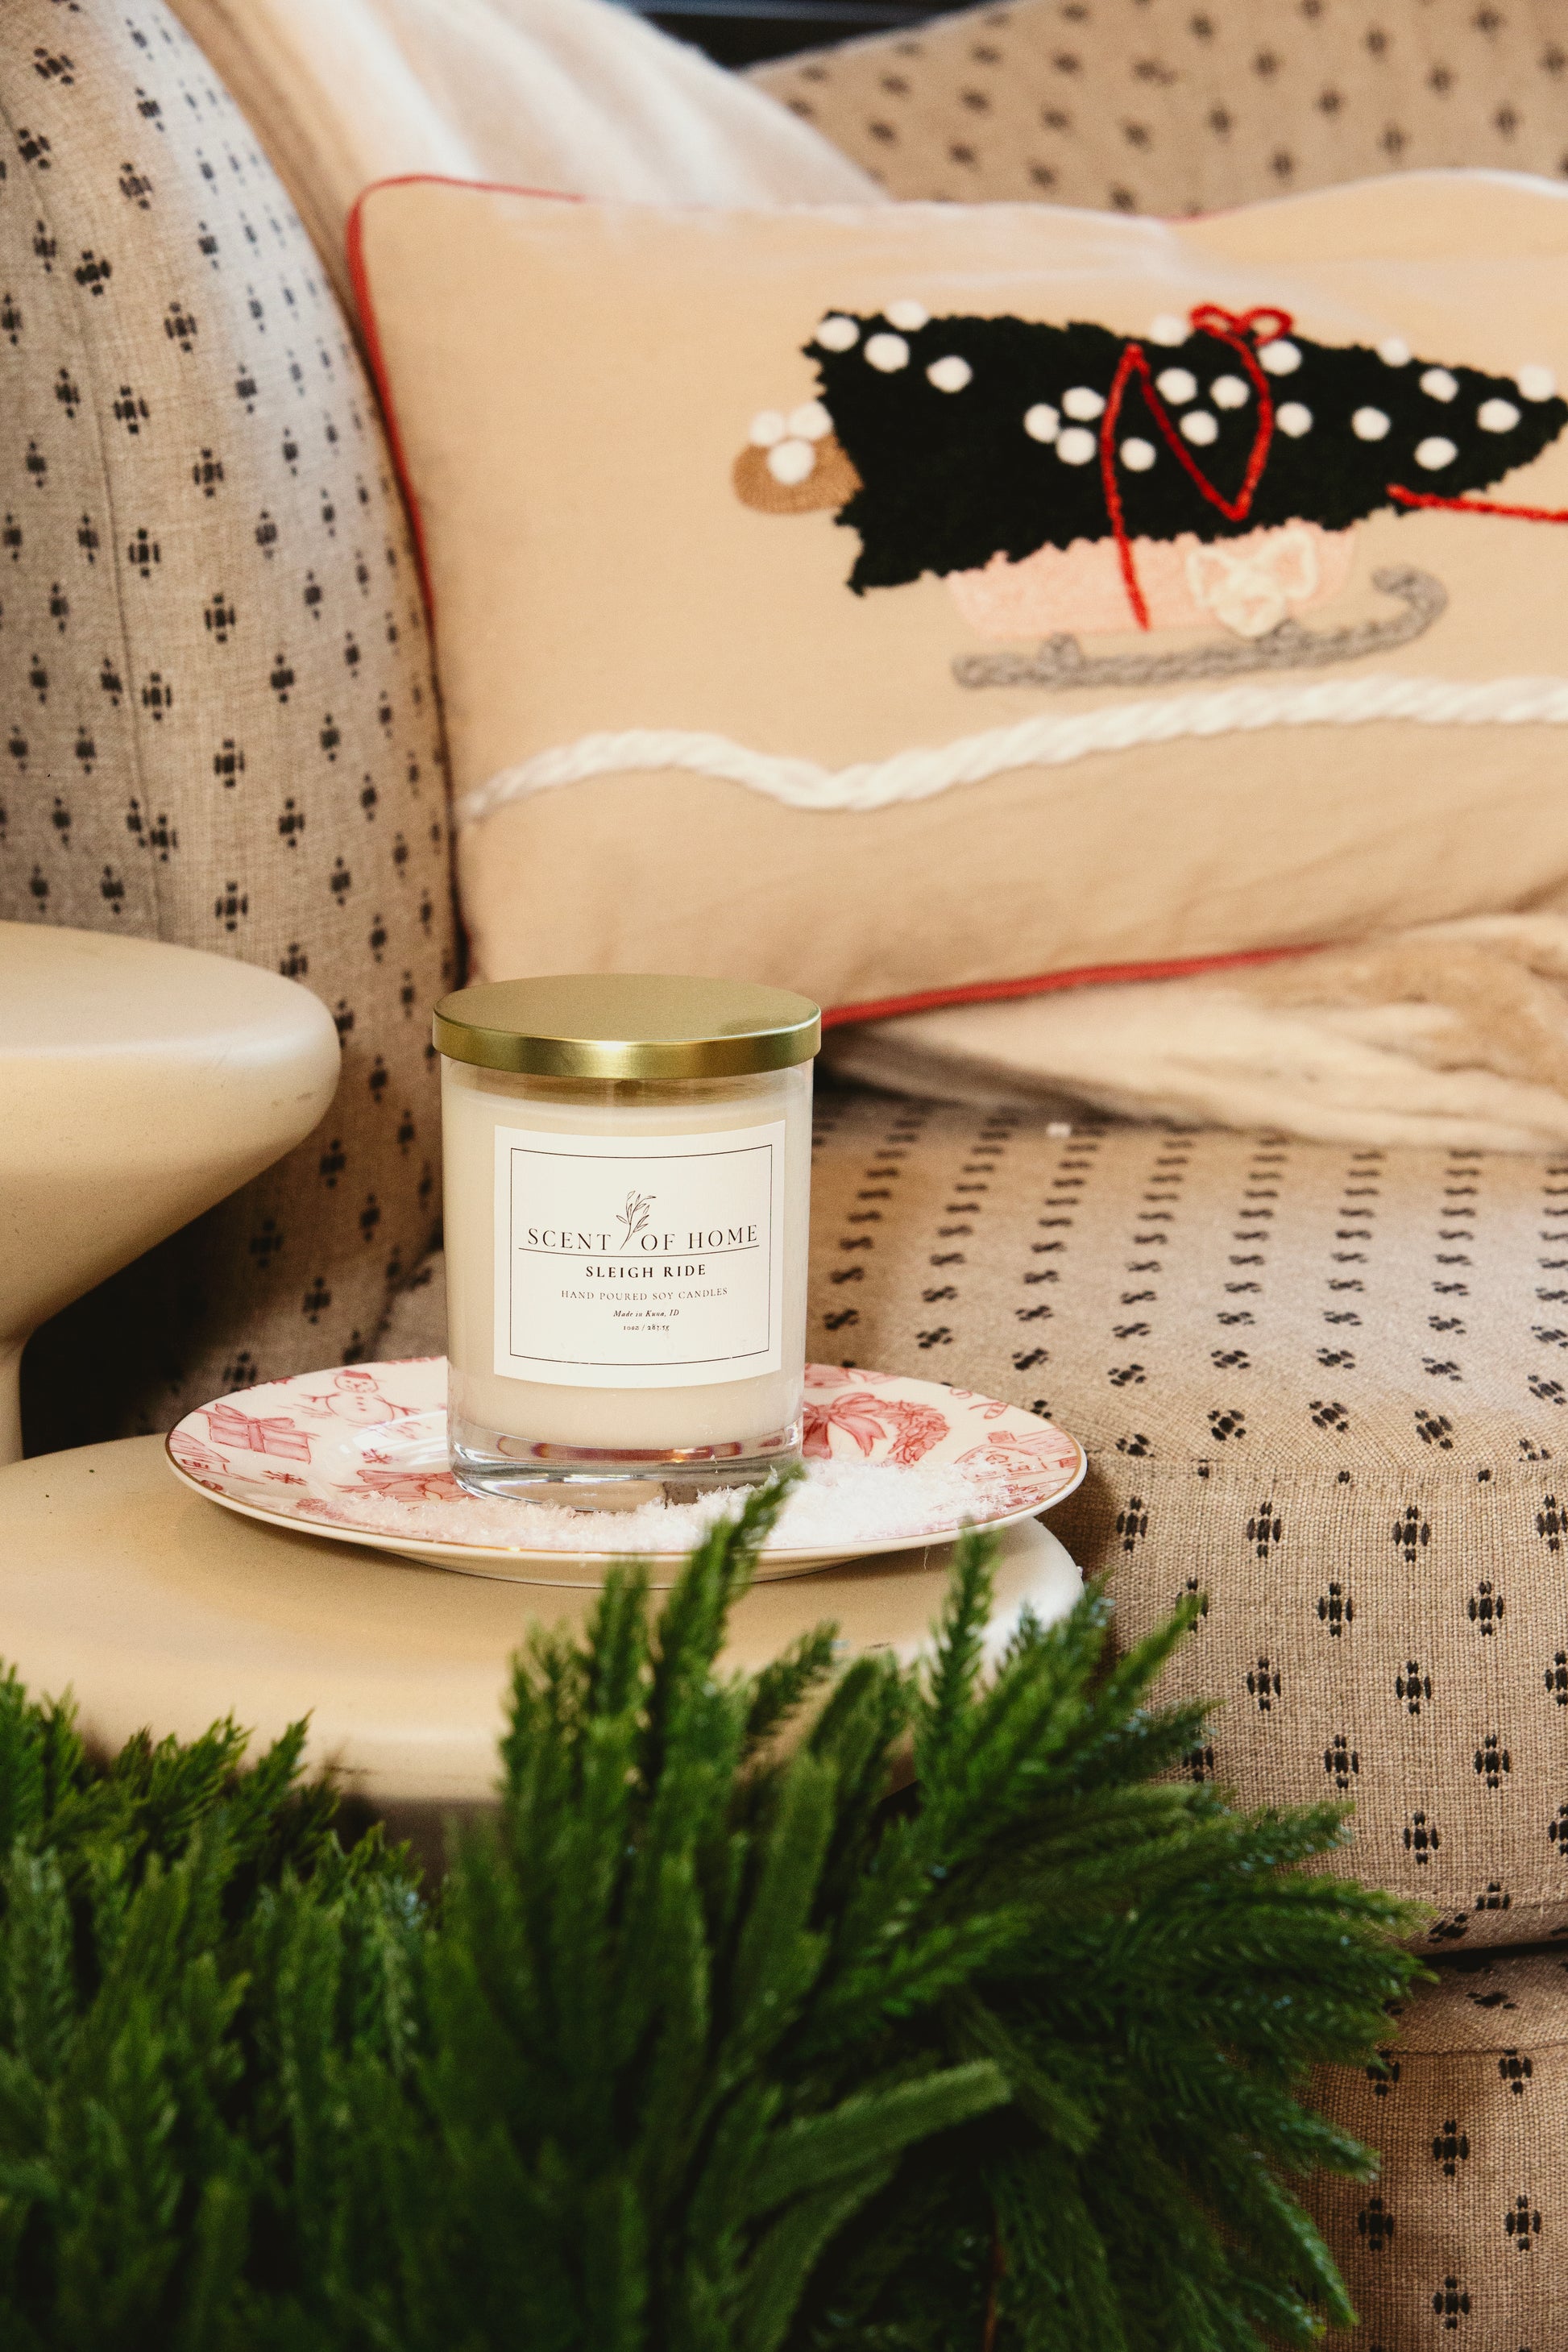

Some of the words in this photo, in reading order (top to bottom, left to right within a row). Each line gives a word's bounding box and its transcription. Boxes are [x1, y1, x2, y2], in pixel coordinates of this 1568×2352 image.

[527, 1228, 612, 1251] SCENT
[641, 1233, 675, 1251] OF
[688, 1225, 758, 1249] HOME
[586, 1266, 653, 1278] SLEIGH
[664, 1263, 706, 1277] RIDE
[561, 1289, 595, 1300] HAND
[599, 1292, 648, 1301] POURED
[652, 1292, 674, 1300] SOY
[678, 1287, 728, 1300] CANDLES
[612, 1309, 634, 1317] Made
[670, 1309, 680, 1317] ID
[641, 1324, 645, 1332] /
